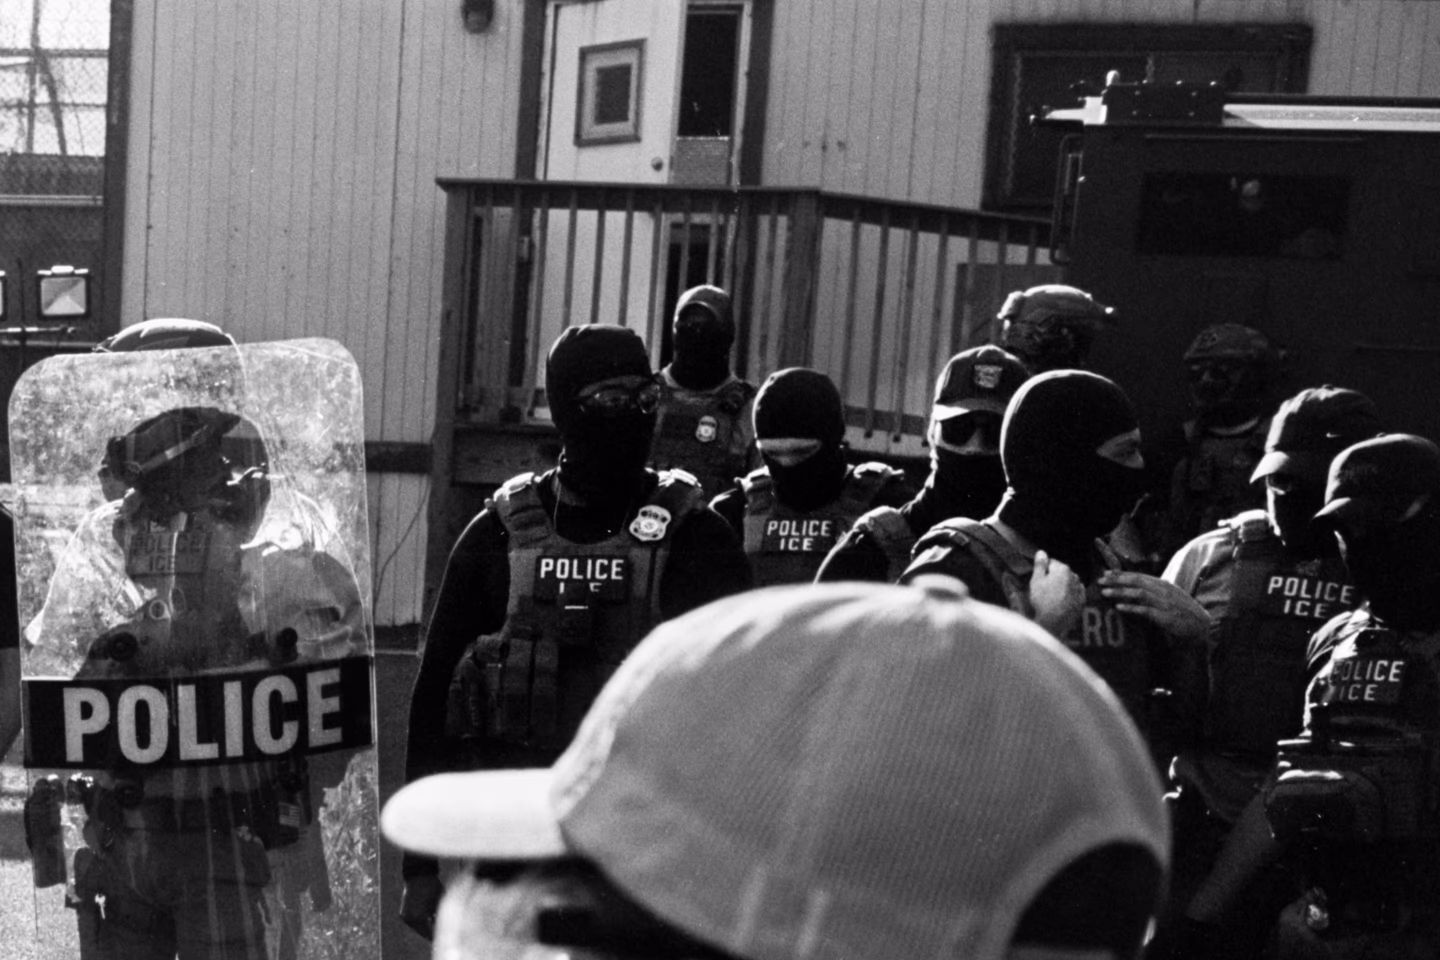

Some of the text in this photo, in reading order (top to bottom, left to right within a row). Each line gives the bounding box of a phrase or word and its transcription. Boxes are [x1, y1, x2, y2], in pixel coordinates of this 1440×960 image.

[767, 520, 832, 537] POLICE
[133, 533, 202, 556] POLICE
[780, 537, 814, 551] ICE
[540, 558, 625, 580] POLICE
[1267, 576, 1356, 605] POLICE
[1283, 599, 1330, 619] ICE
[1339, 684, 1378, 701] ICE
[63, 668, 343, 764] POLICE
